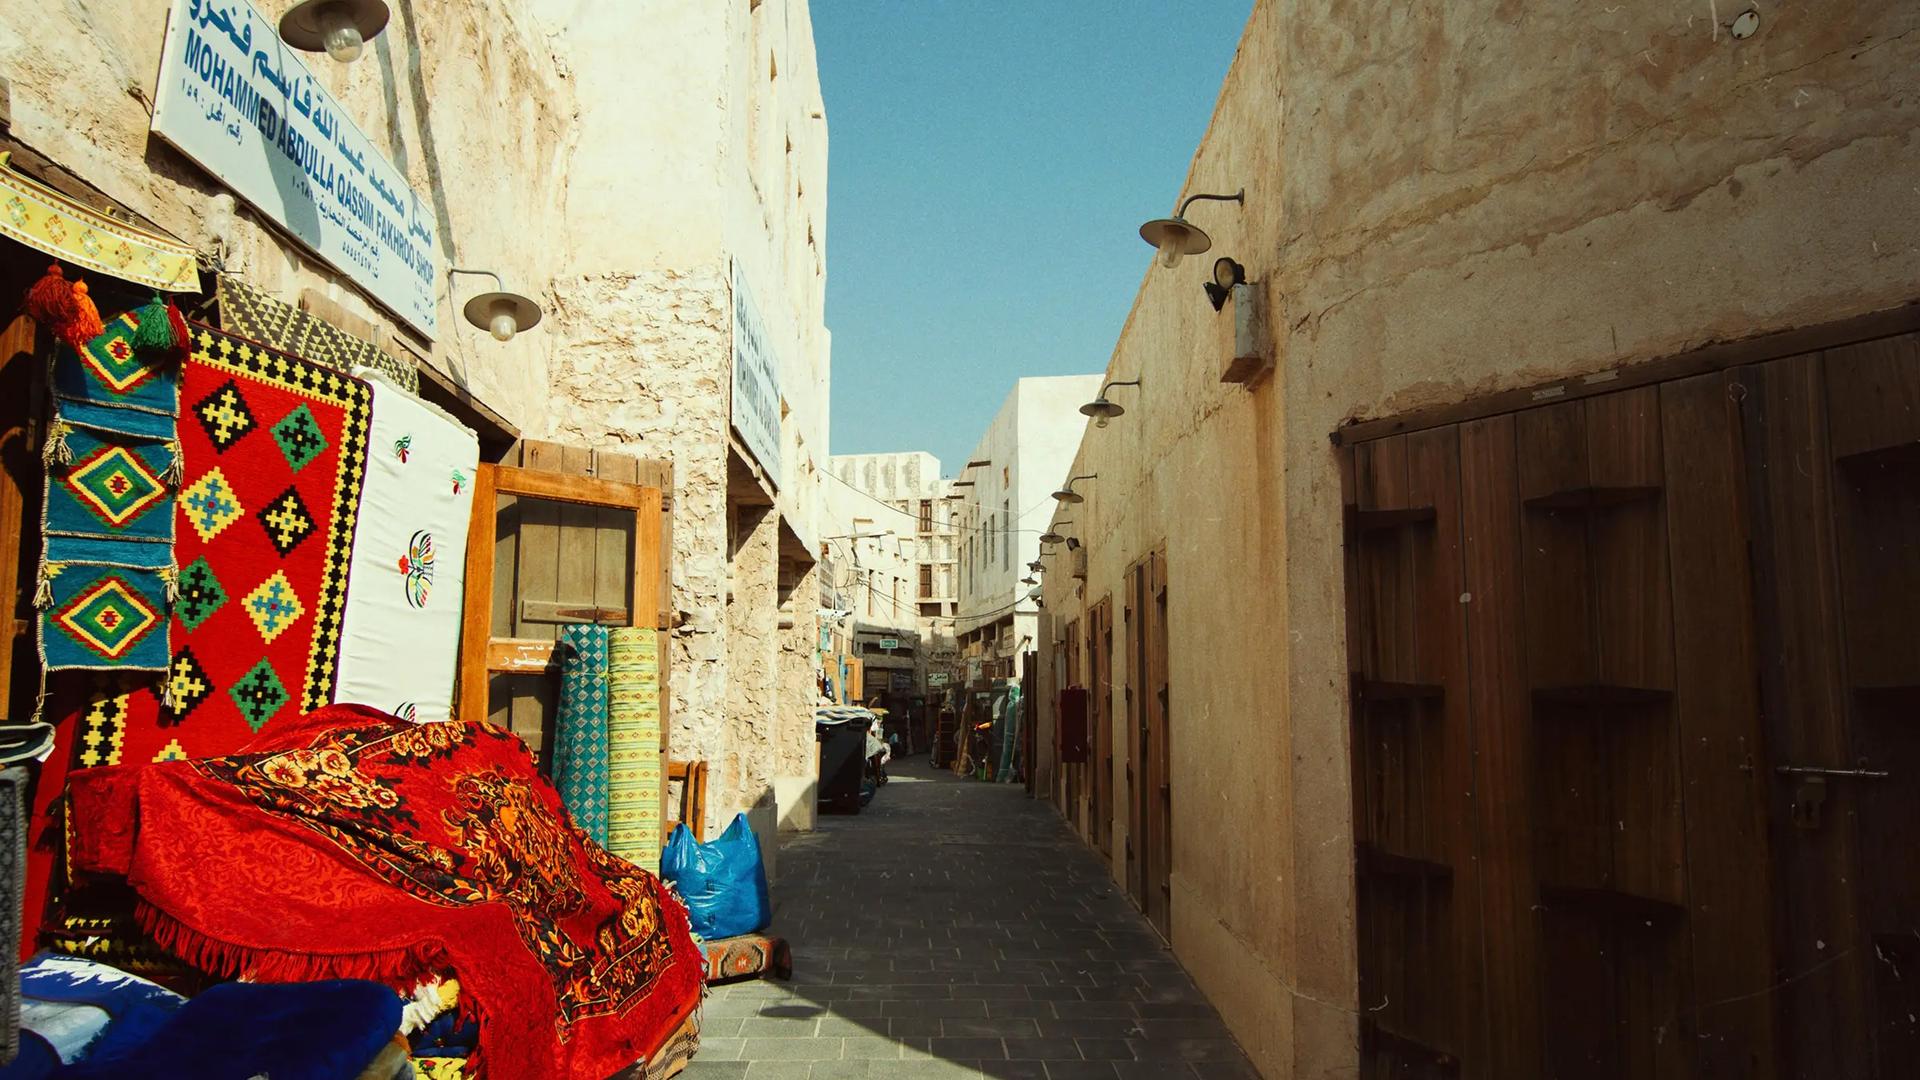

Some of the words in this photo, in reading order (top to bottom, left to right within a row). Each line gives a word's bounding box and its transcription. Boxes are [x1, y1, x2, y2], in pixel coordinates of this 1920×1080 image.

[182, 78, 198, 103] ١٥٩
[251, 50, 312, 119] قاسم
[226, 118, 243, 146] رقم
[184, 27, 277, 141] MOHAMMED
[277, 118, 334, 195] ABDULLA
[337, 173, 374, 232] QASSIM
[376, 209, 415, 270] FAKHROO
[416, 250, 434, 288] SHOP
[369, 168, 405, 219] محمد
[408, 205, 432, 248] محل
